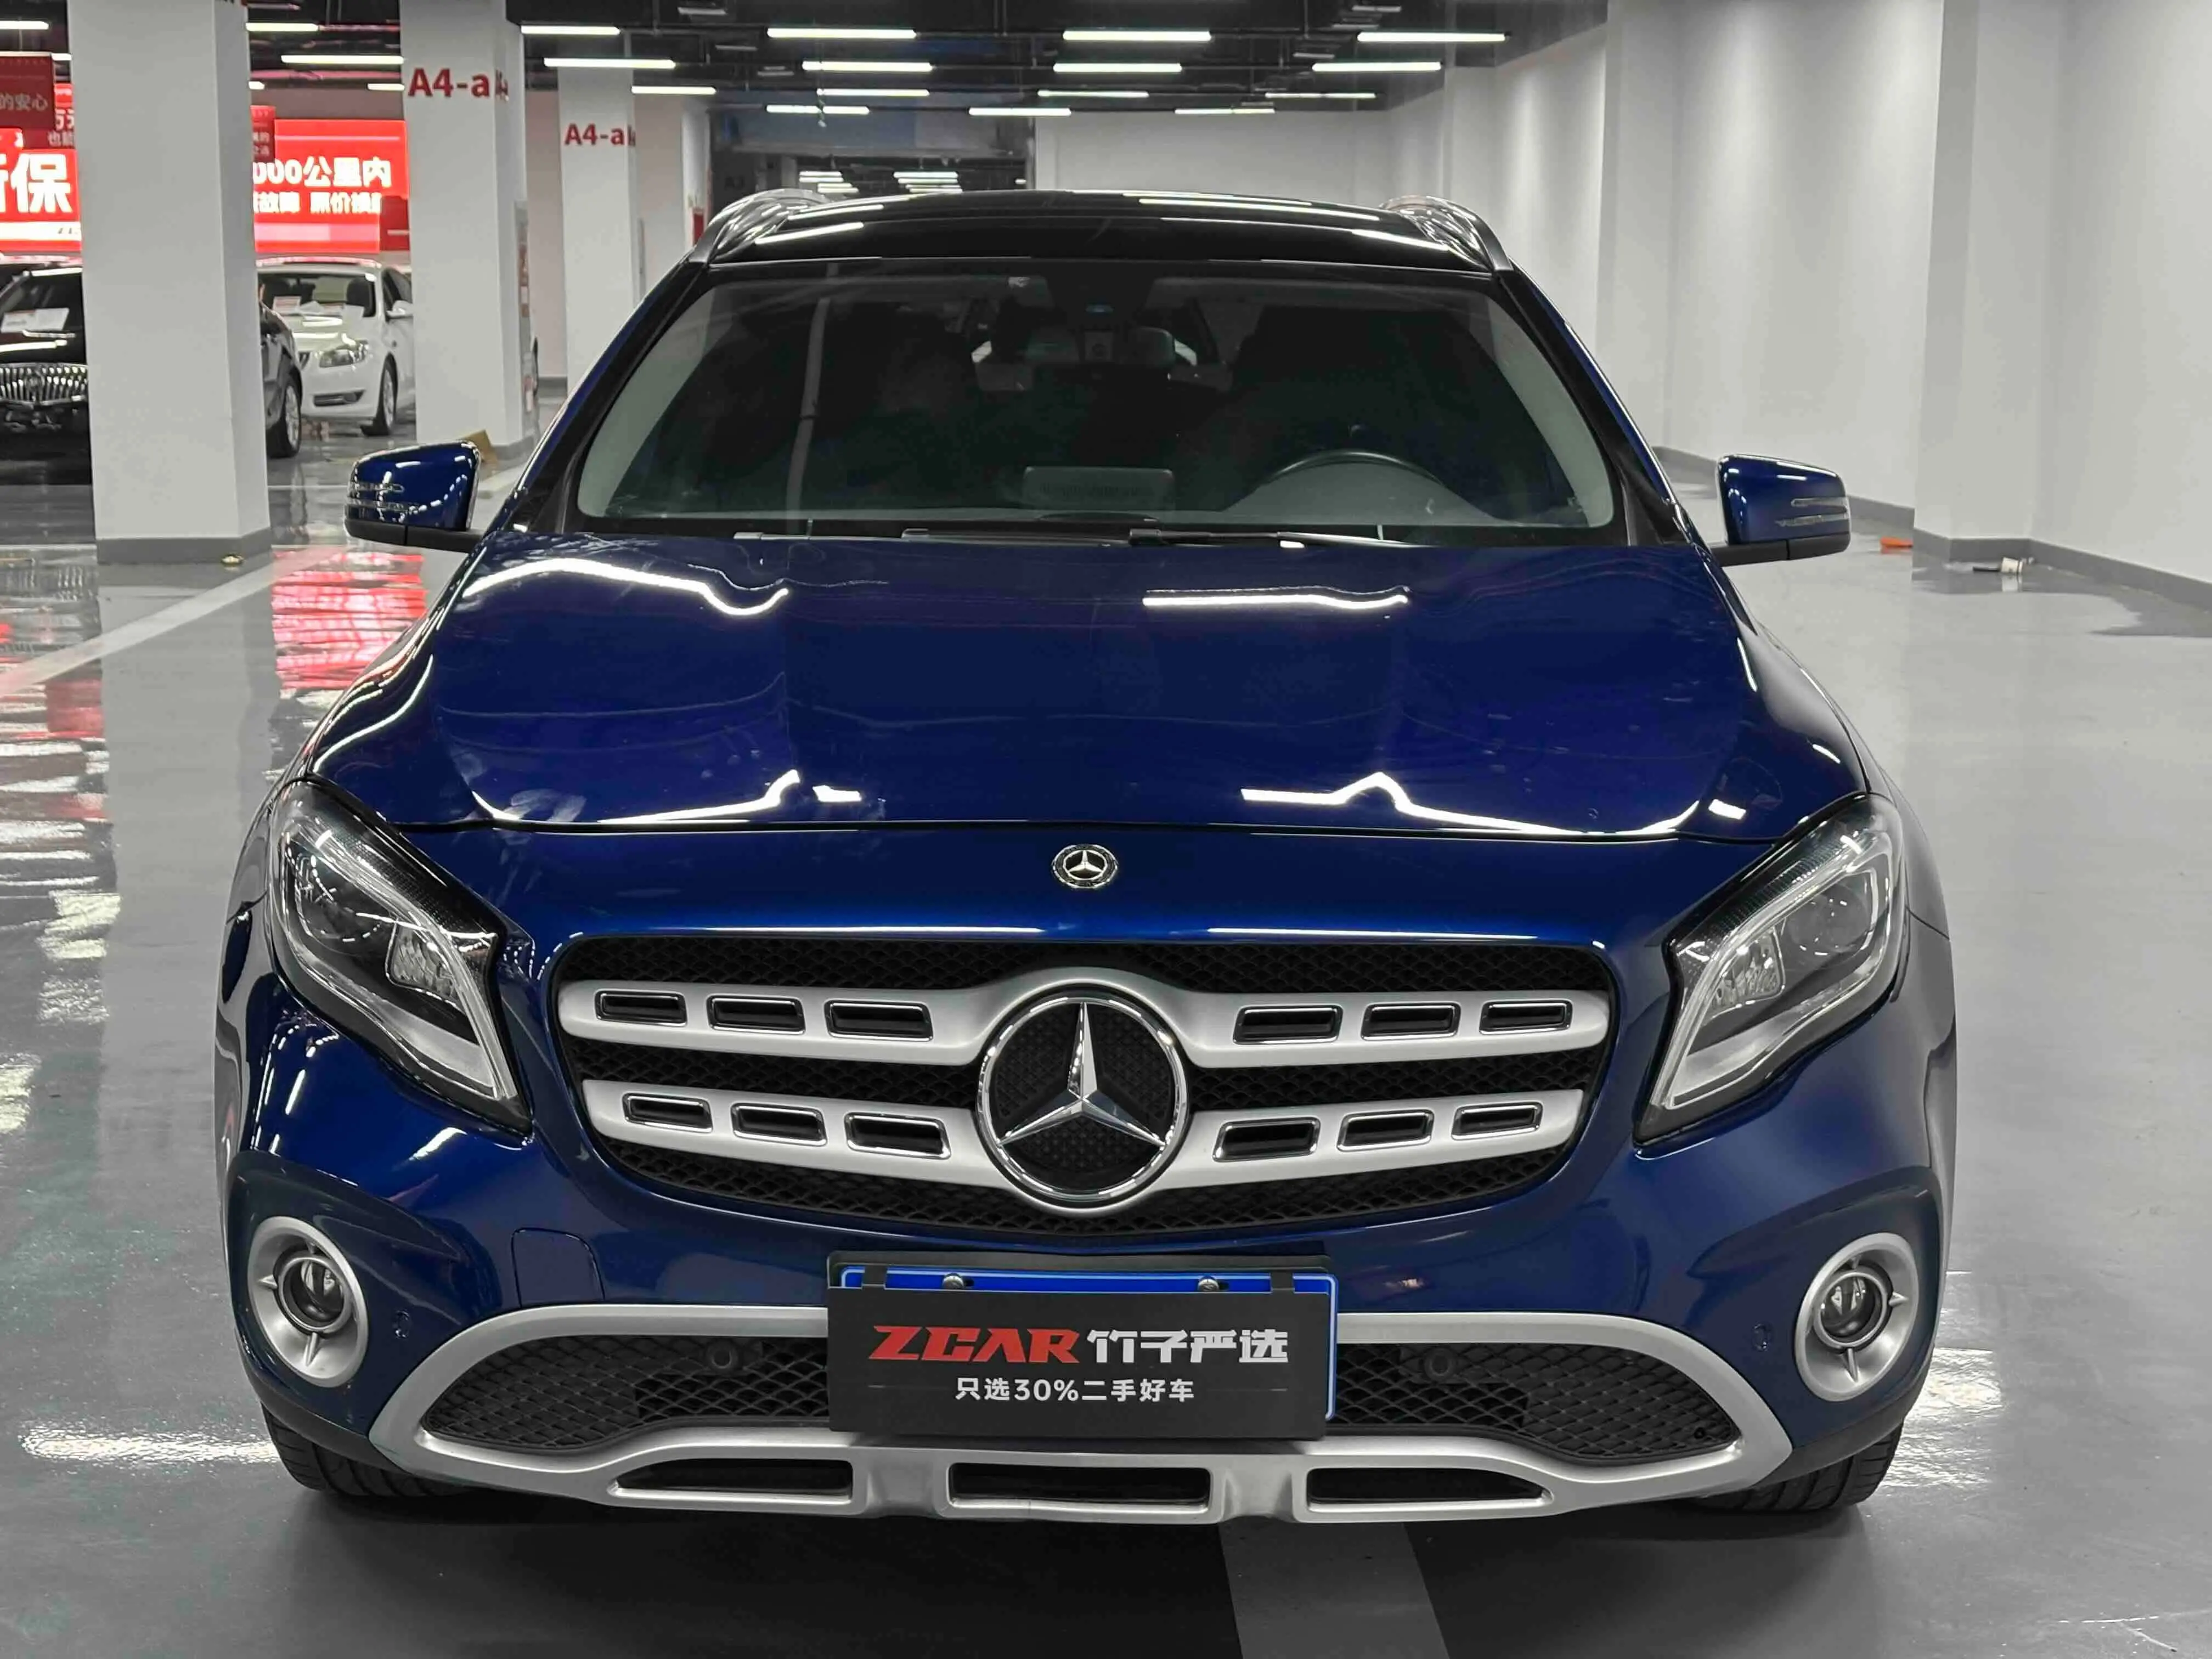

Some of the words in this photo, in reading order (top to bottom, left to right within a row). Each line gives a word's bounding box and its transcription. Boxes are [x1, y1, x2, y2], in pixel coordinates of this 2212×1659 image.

[868, 1325, 1080, 1364] ZCAR
[1086, 1329, 1289, 1363] 竹子严选
[955, 1378, 1194, 1403] 只选30%二手好车
